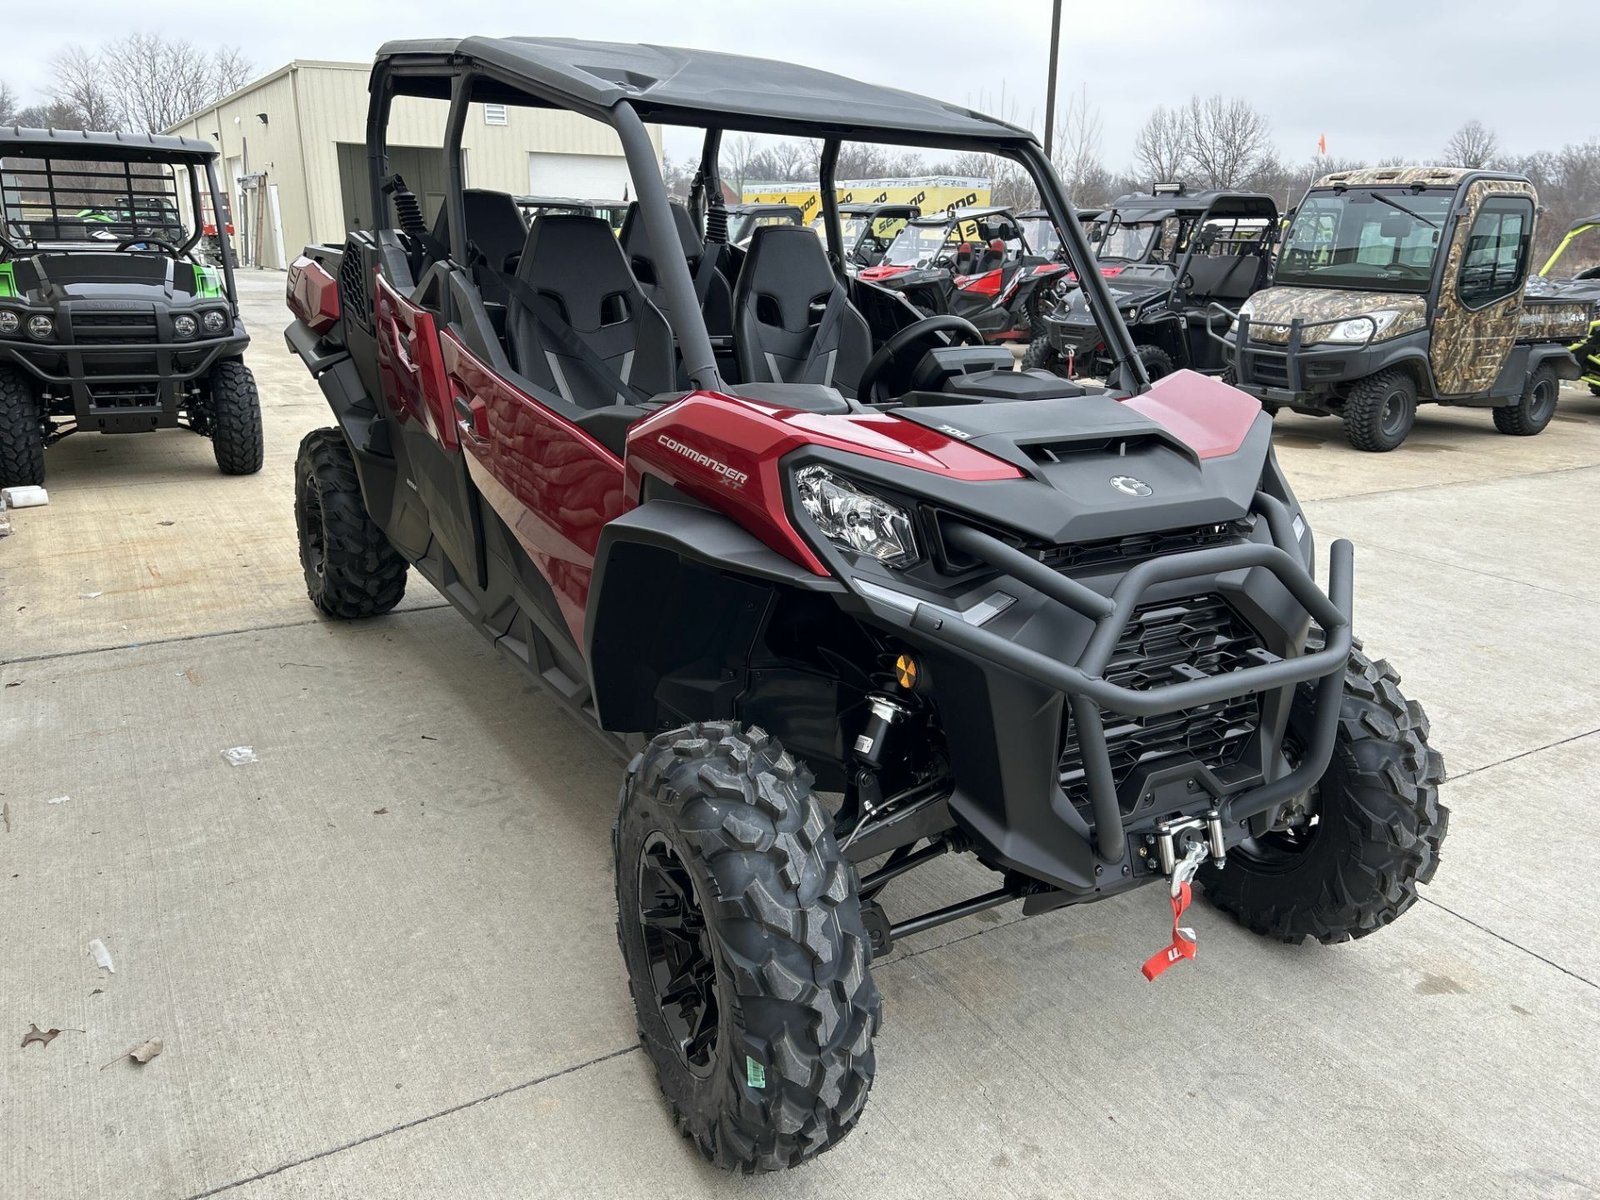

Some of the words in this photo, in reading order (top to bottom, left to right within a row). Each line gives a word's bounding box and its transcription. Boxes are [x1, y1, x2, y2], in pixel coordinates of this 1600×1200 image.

[938, 424, 971, 439] 700
[657, 434, 748, 484] COMMANDER
[720, 476, 743, 490] XT
